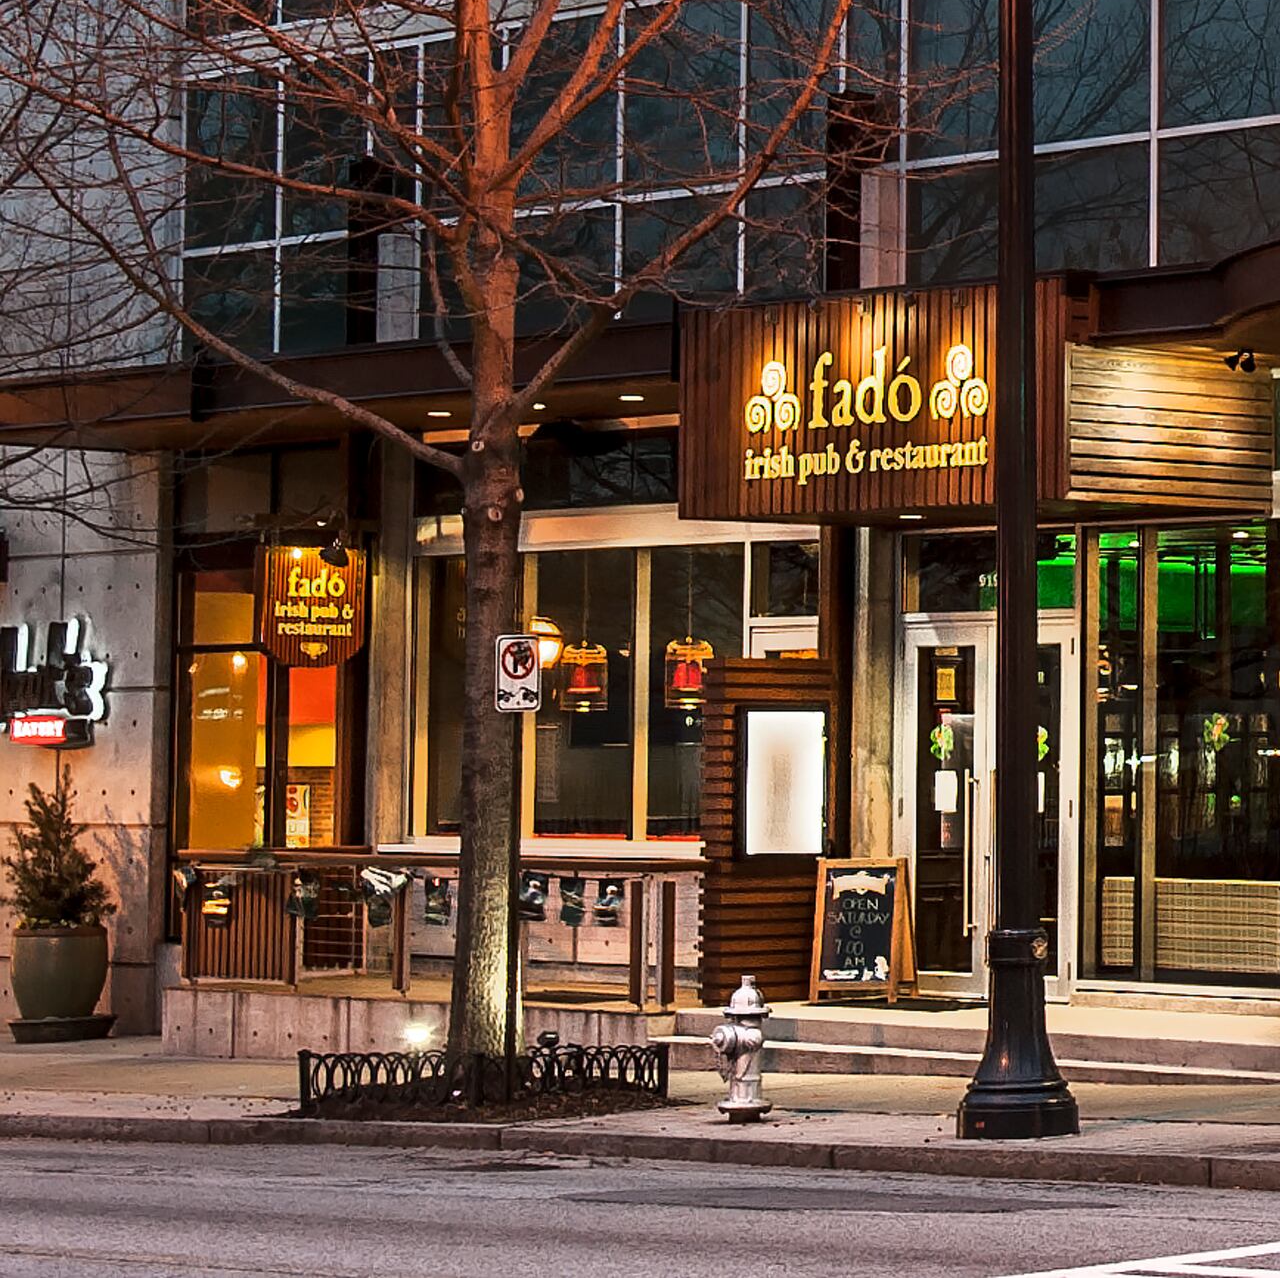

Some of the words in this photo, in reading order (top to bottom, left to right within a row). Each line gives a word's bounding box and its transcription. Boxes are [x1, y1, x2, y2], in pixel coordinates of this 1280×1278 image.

[808, 346, 922, 429] fadó
[745, 447, 795, 480] irish
[797, 443, 840, 485] pub
[845, 439, 866, 474] &
[869, 435, 988, 472] restaurant
[287, 566, 346, 598] fadó
[275, 601, 309, 618] irish
[311, 602, 339, 622] pub
[277, 622, 352, 636] restaurant
[14, 720, 64, 738] EATERY
[842, 898, 879, 910] OPEN
[827, 912, 890, 925] SATURDAY
[844, 956, 866, 968] AM
